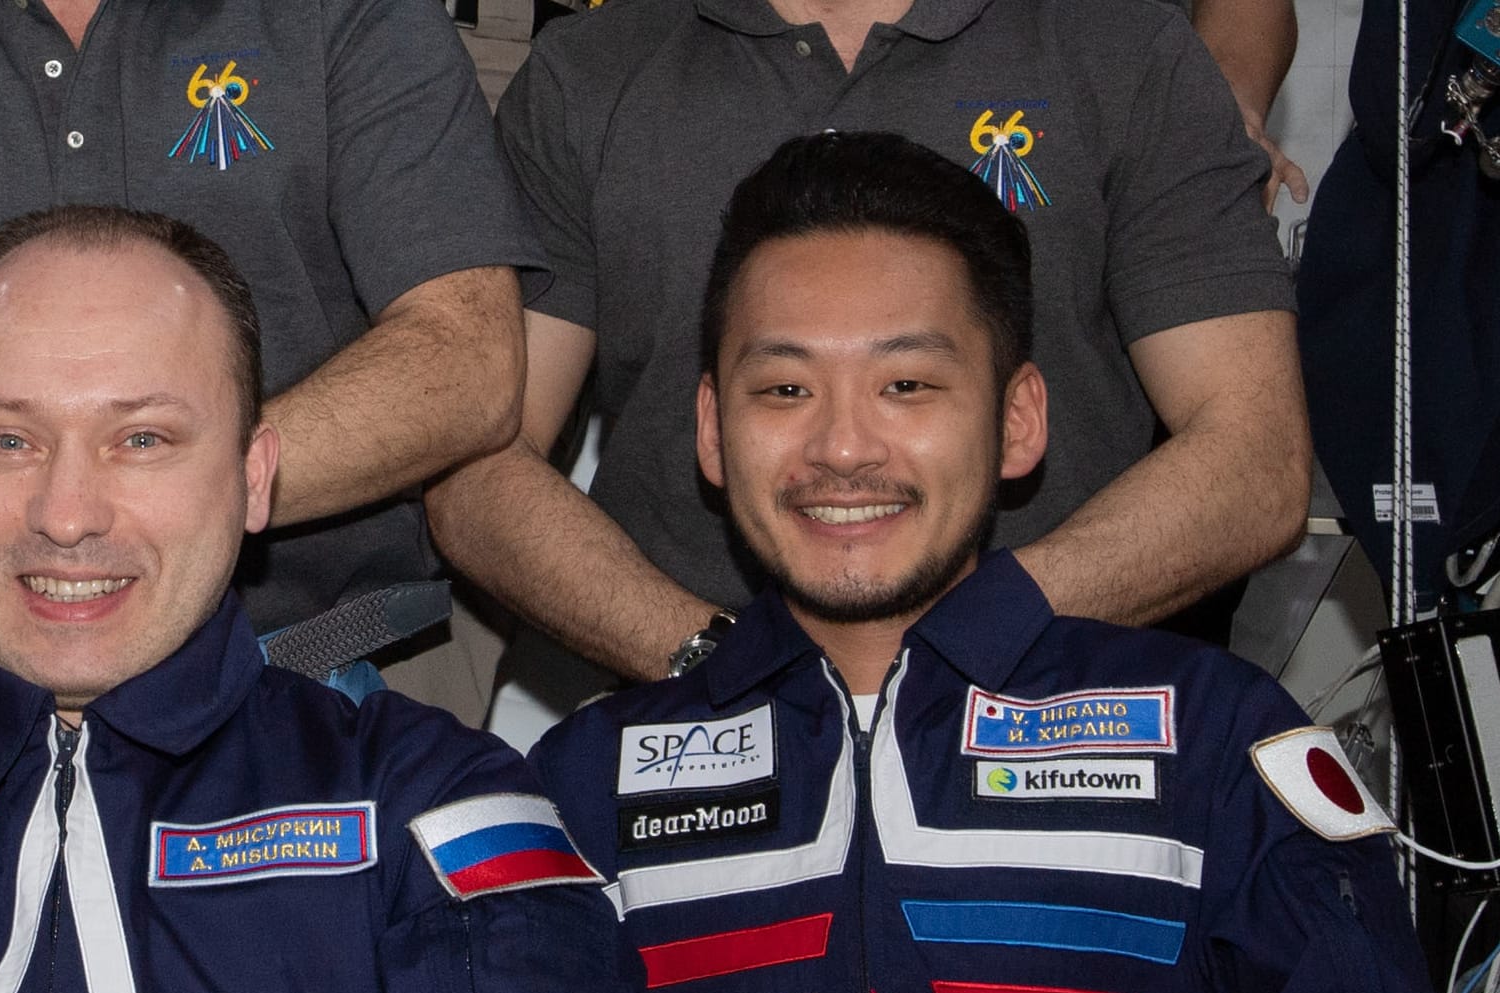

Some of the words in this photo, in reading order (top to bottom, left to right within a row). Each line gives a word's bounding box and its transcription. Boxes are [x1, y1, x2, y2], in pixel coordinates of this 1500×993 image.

[187, 60, 249, 108] 66
[970, 109, 1034, 157] 66
[1041, 702, 1128, 723] HIRANO
[635, 722, 757, 764] SPACE
[1039, 721, 1131, 741] ХИРАНО
[1025, 769, 1141, 790] kifutown
[216, 819, 341, 850] МИСУРКИН
[632, 802, 767, 839] dearMoon
[221, 842, 338, 868] MISURKIN
